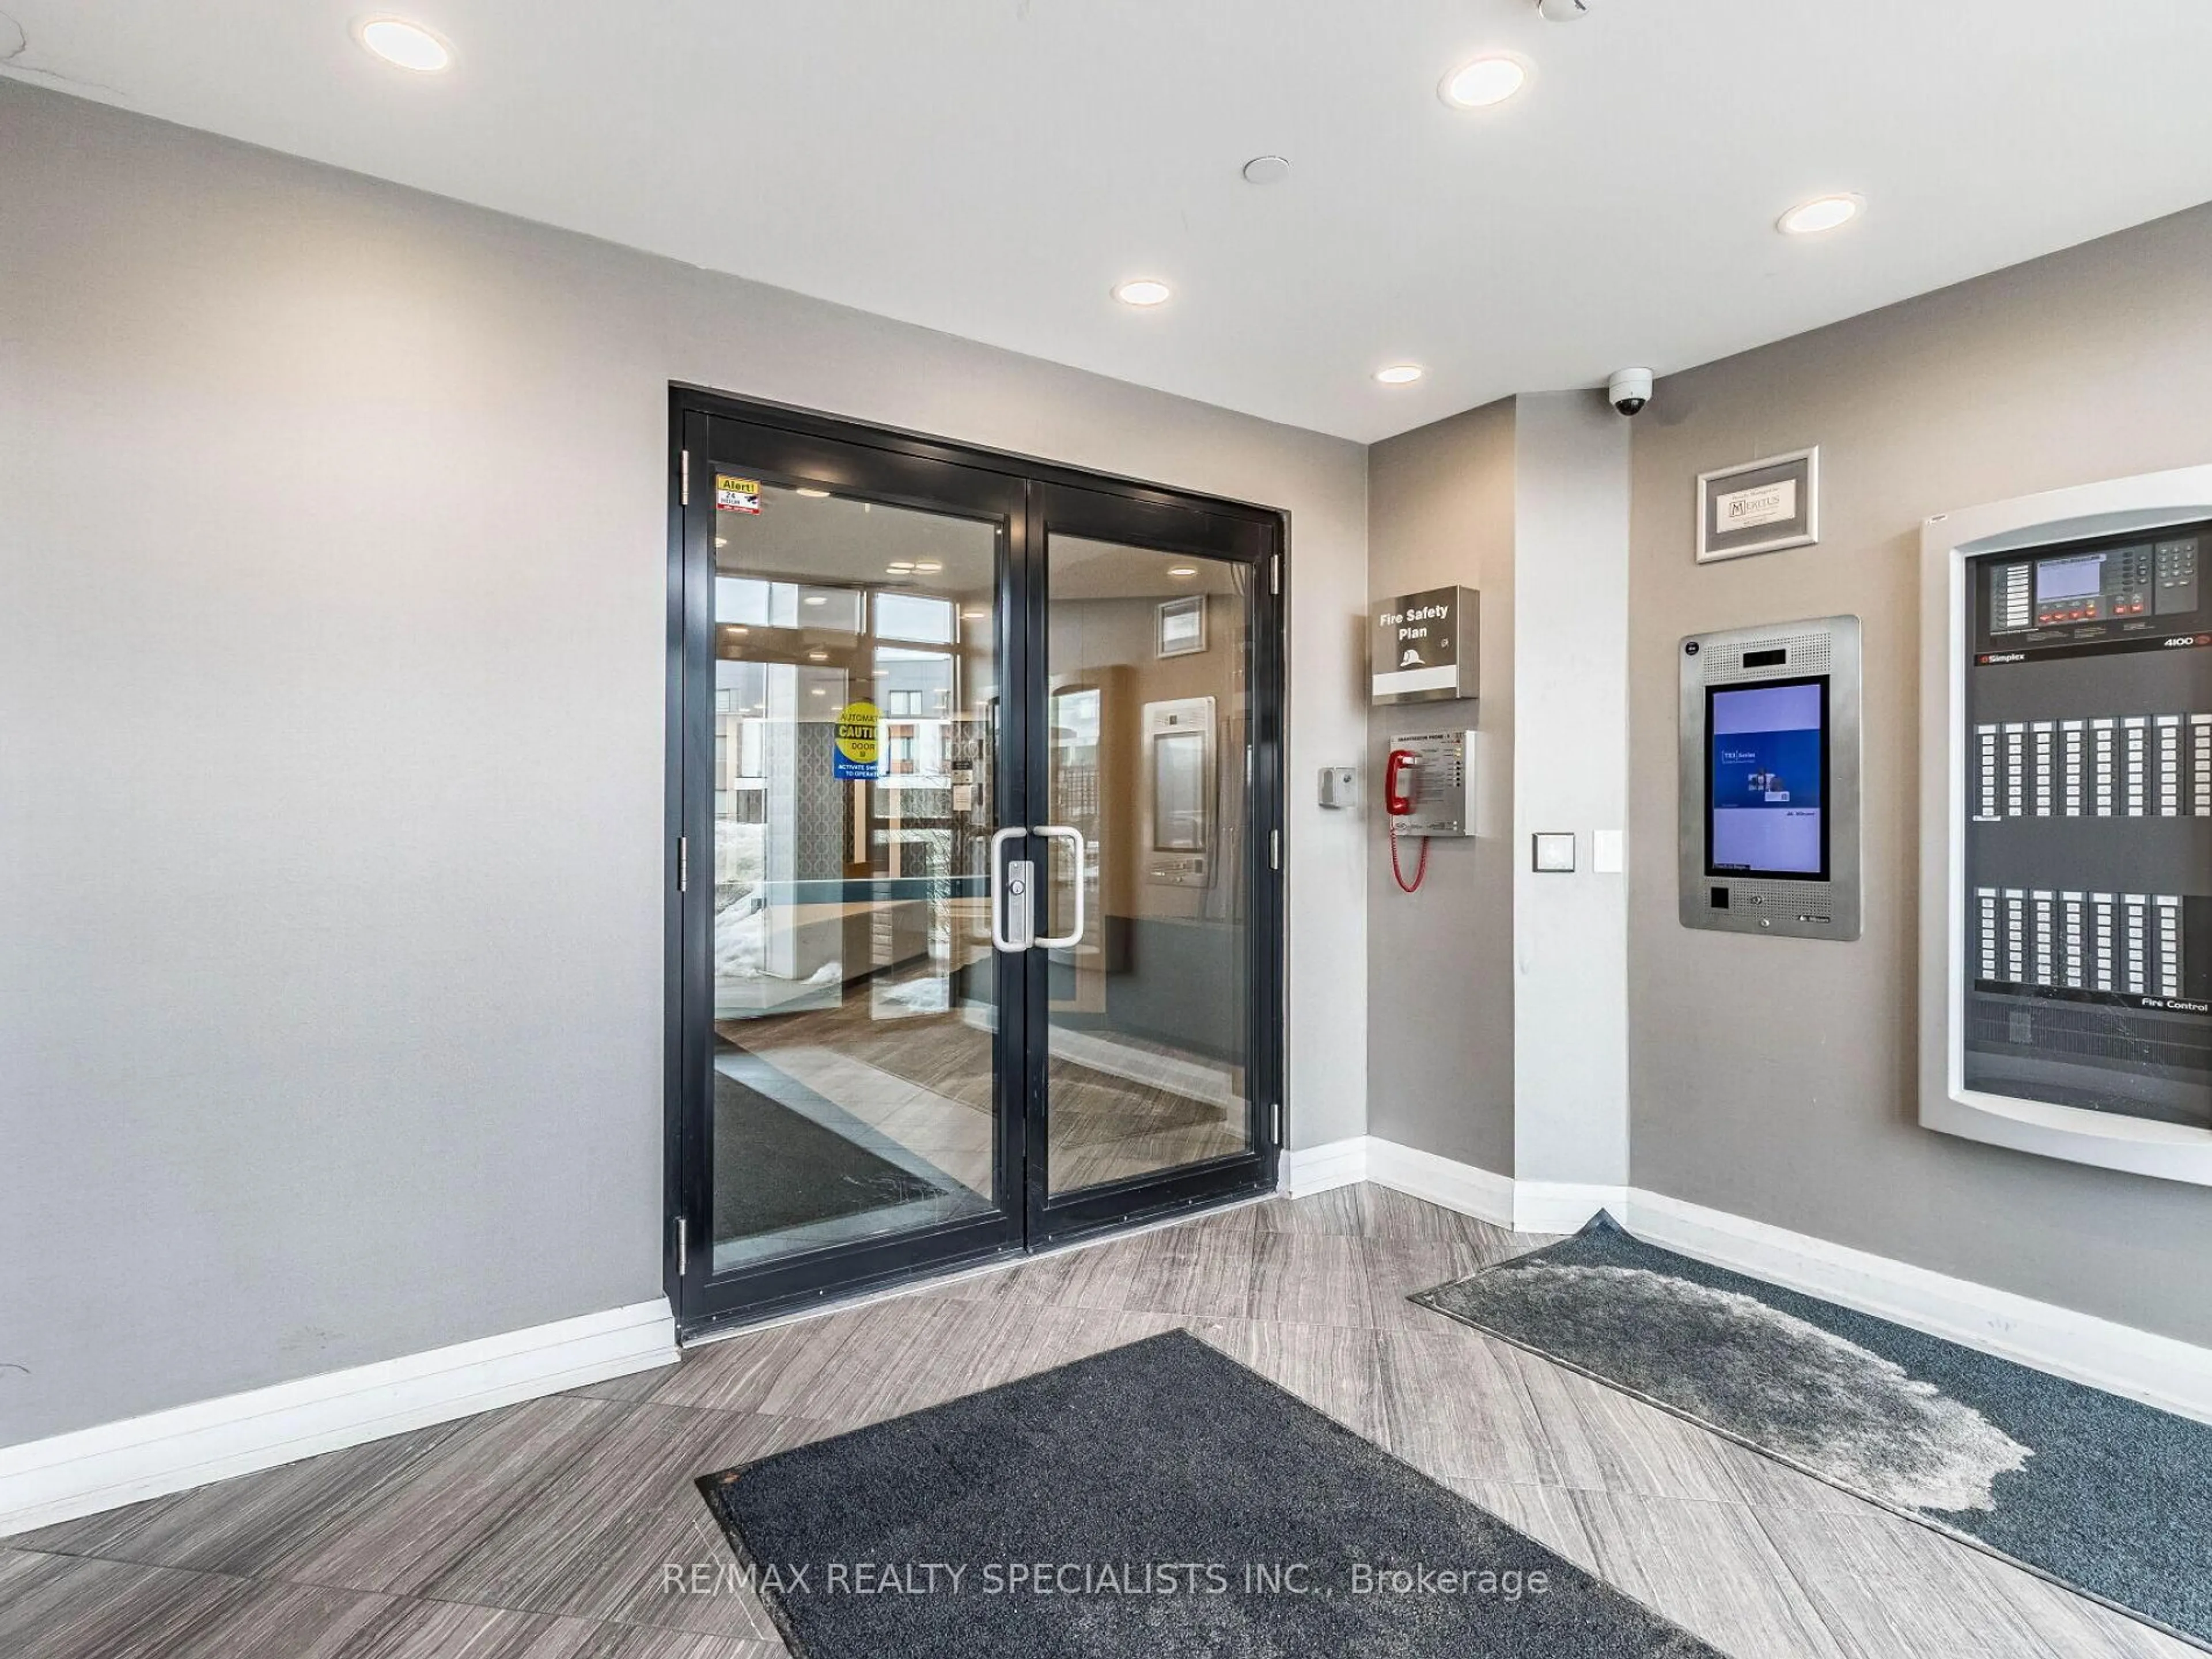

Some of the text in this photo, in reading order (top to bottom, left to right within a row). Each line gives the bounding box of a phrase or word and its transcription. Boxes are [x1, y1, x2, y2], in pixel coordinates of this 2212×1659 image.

[1380, 605, 1449, 626] Fire Safety
[1399, 627, 1427, 641] Plan
[2164, 638, 2193, 646] 4100
[2142, 998, 2207, 1012] Fire Control
